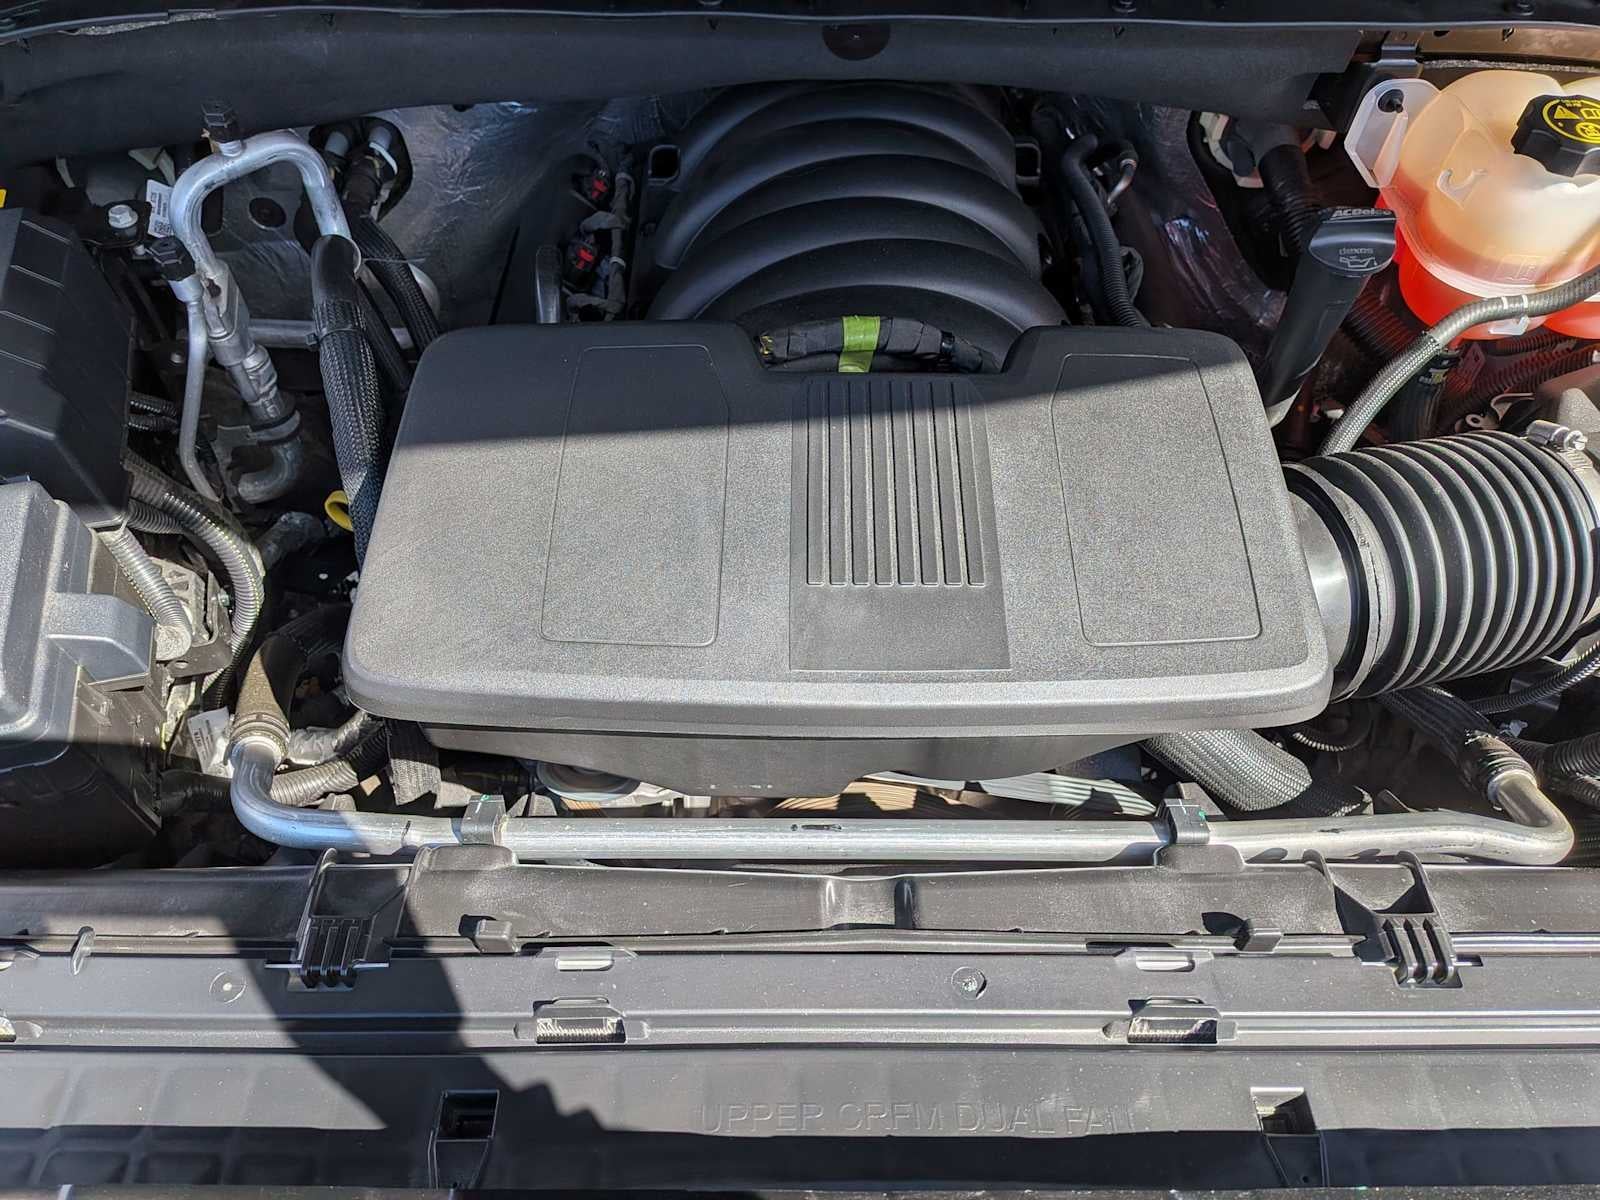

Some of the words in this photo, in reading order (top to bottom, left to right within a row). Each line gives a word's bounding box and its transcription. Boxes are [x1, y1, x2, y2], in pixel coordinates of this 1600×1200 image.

[1332, 207, 1392, 218] ACDelco
[701, 1102, 826, 1134] UPPER
[955, 1102, 1056, 1134] DUAL
